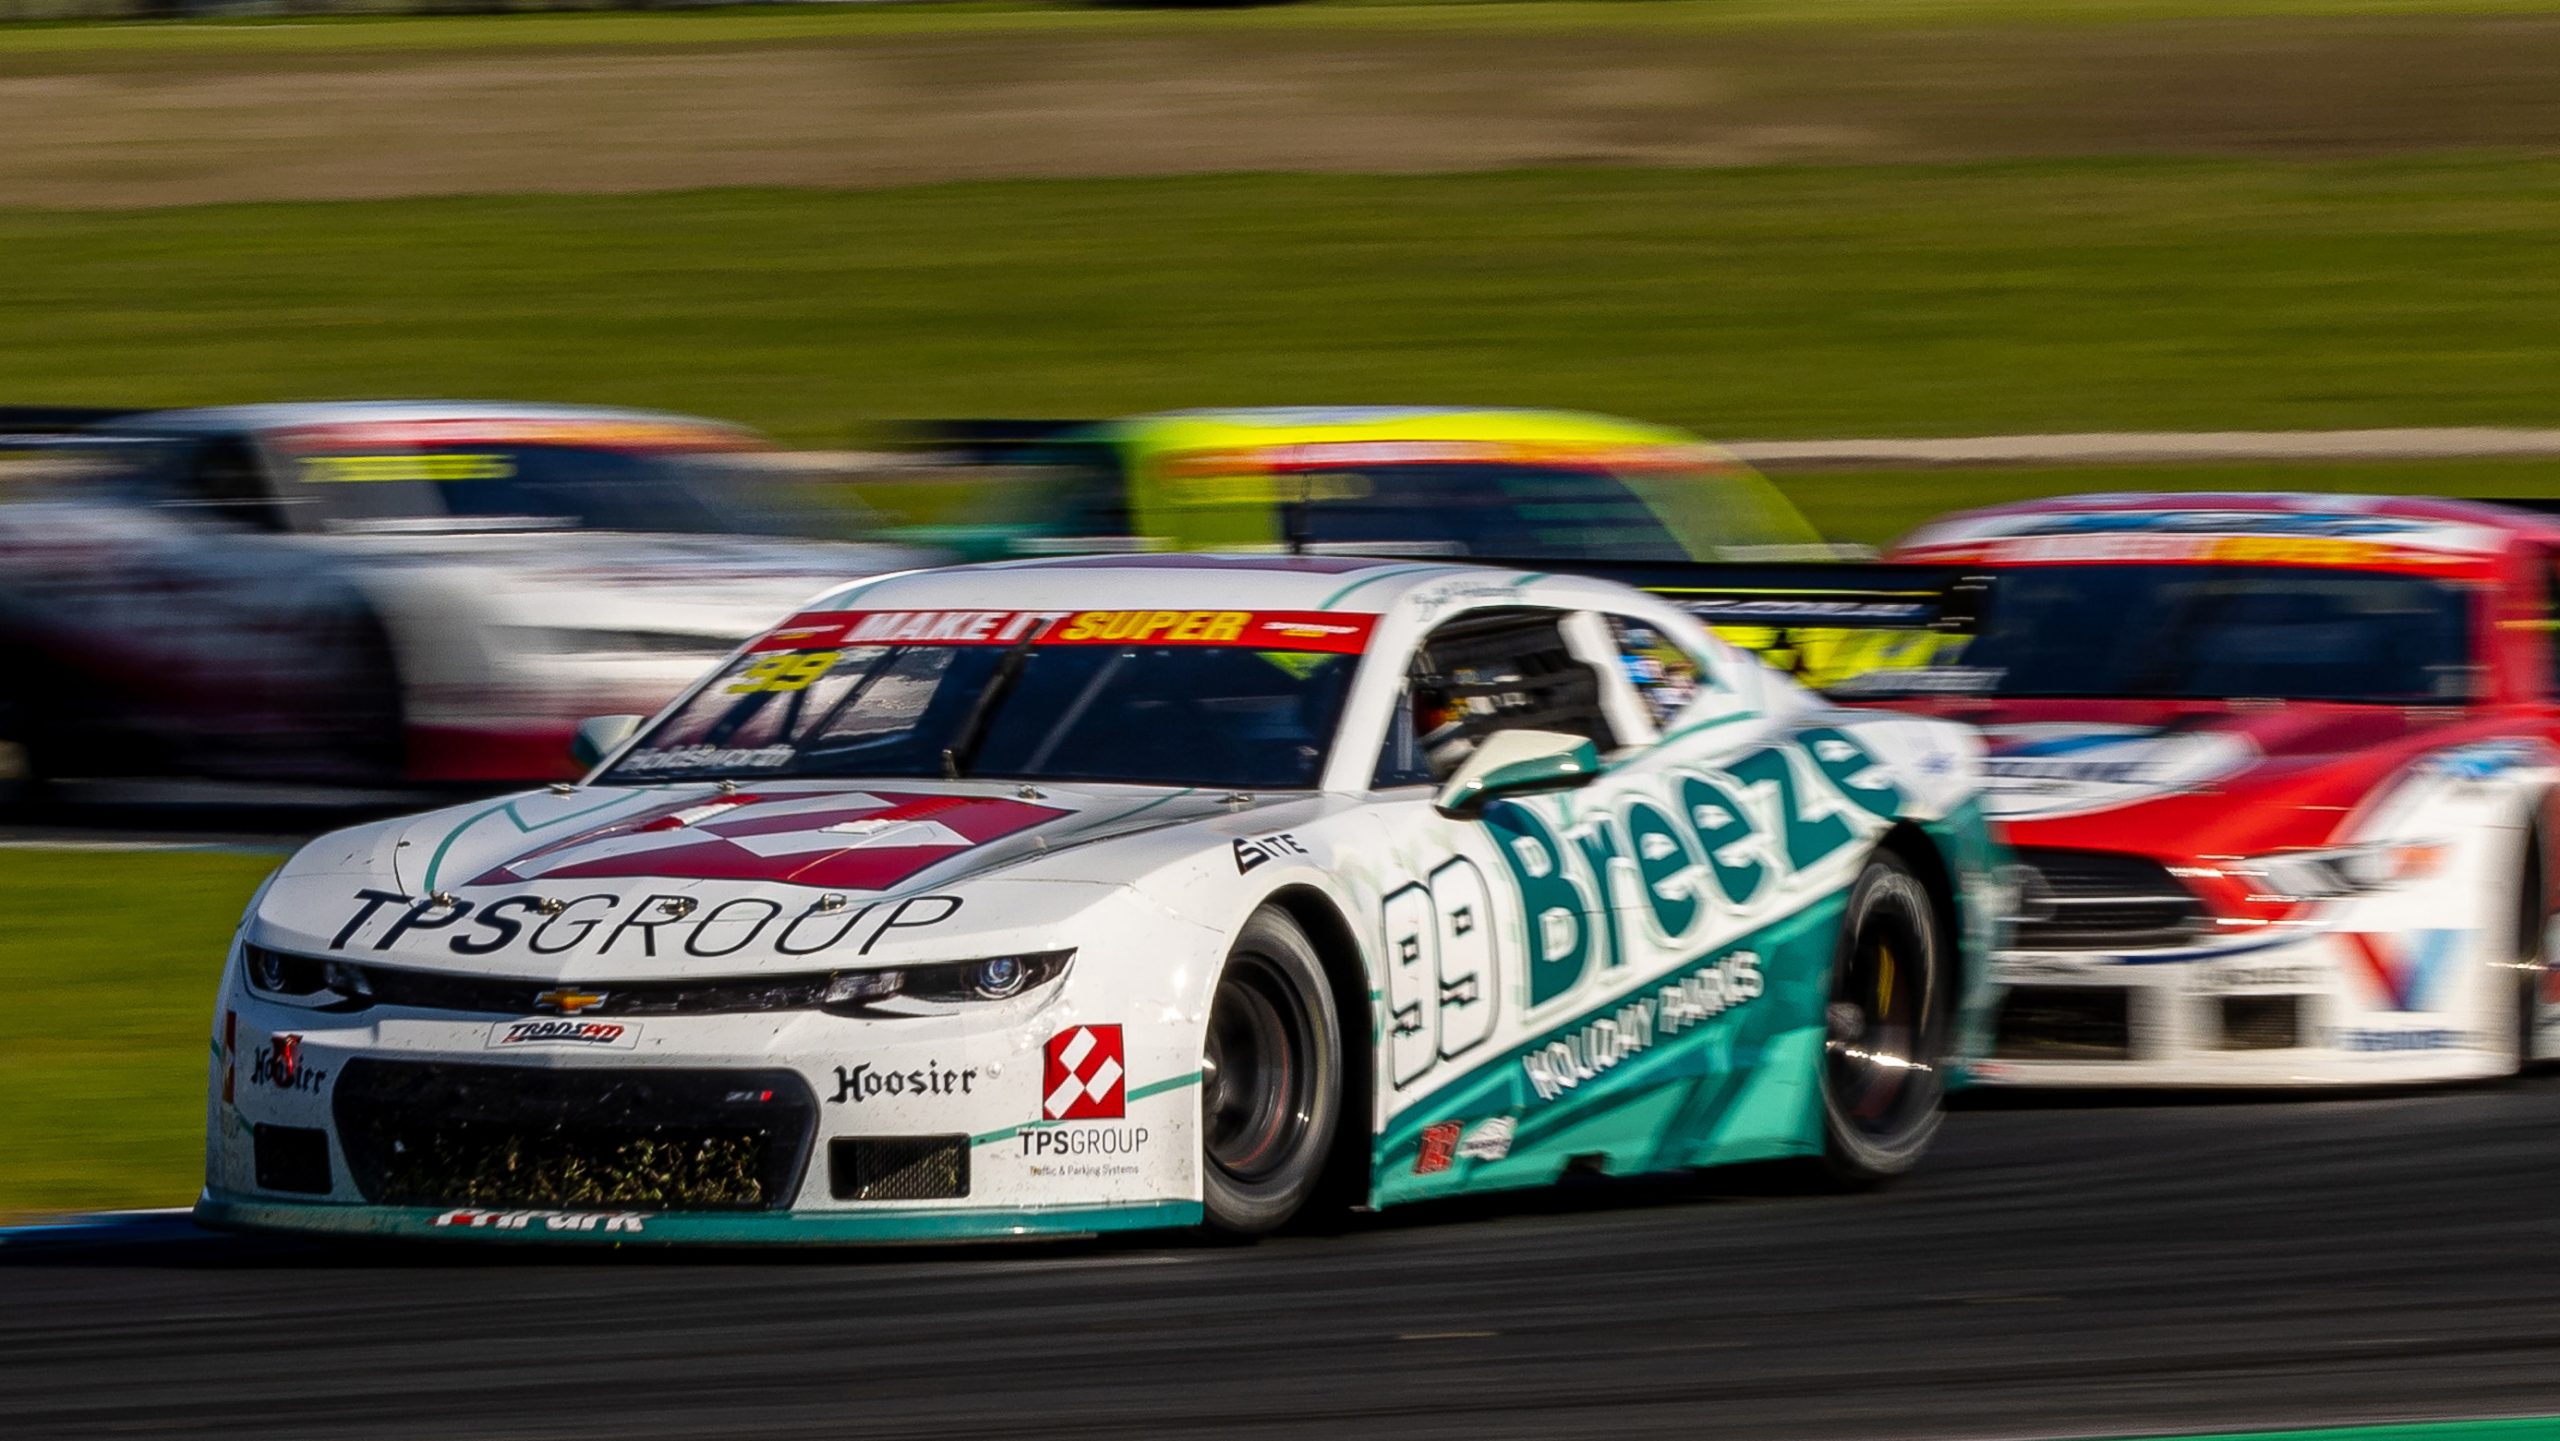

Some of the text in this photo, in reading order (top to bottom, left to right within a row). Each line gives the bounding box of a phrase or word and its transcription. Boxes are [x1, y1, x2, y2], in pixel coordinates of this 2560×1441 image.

[840, 612, 1007, 643] MAKE
[993, 612, 1074, 641] IT
[1059, 611, 1252, 641] SUPER
[724, 651, 842, 694] 99
[1480, 727, 1902, 1008] Breeze
[327, 888, 964, 958] TPSGROUP
[1379, 854, 1500, 1091] 99
[1522, 950, 1765, 1100] HOLIDAY PARKS
[827, 1058, 978, 1104] Hoosier
[1018, 1127, 1149, 1156] TPSGROUP
[1058, 1166, 1066, 1176] &
[1067, 1165, 1101, 1178] Parking
[1102, 1164, 1140, 1176] Systems
